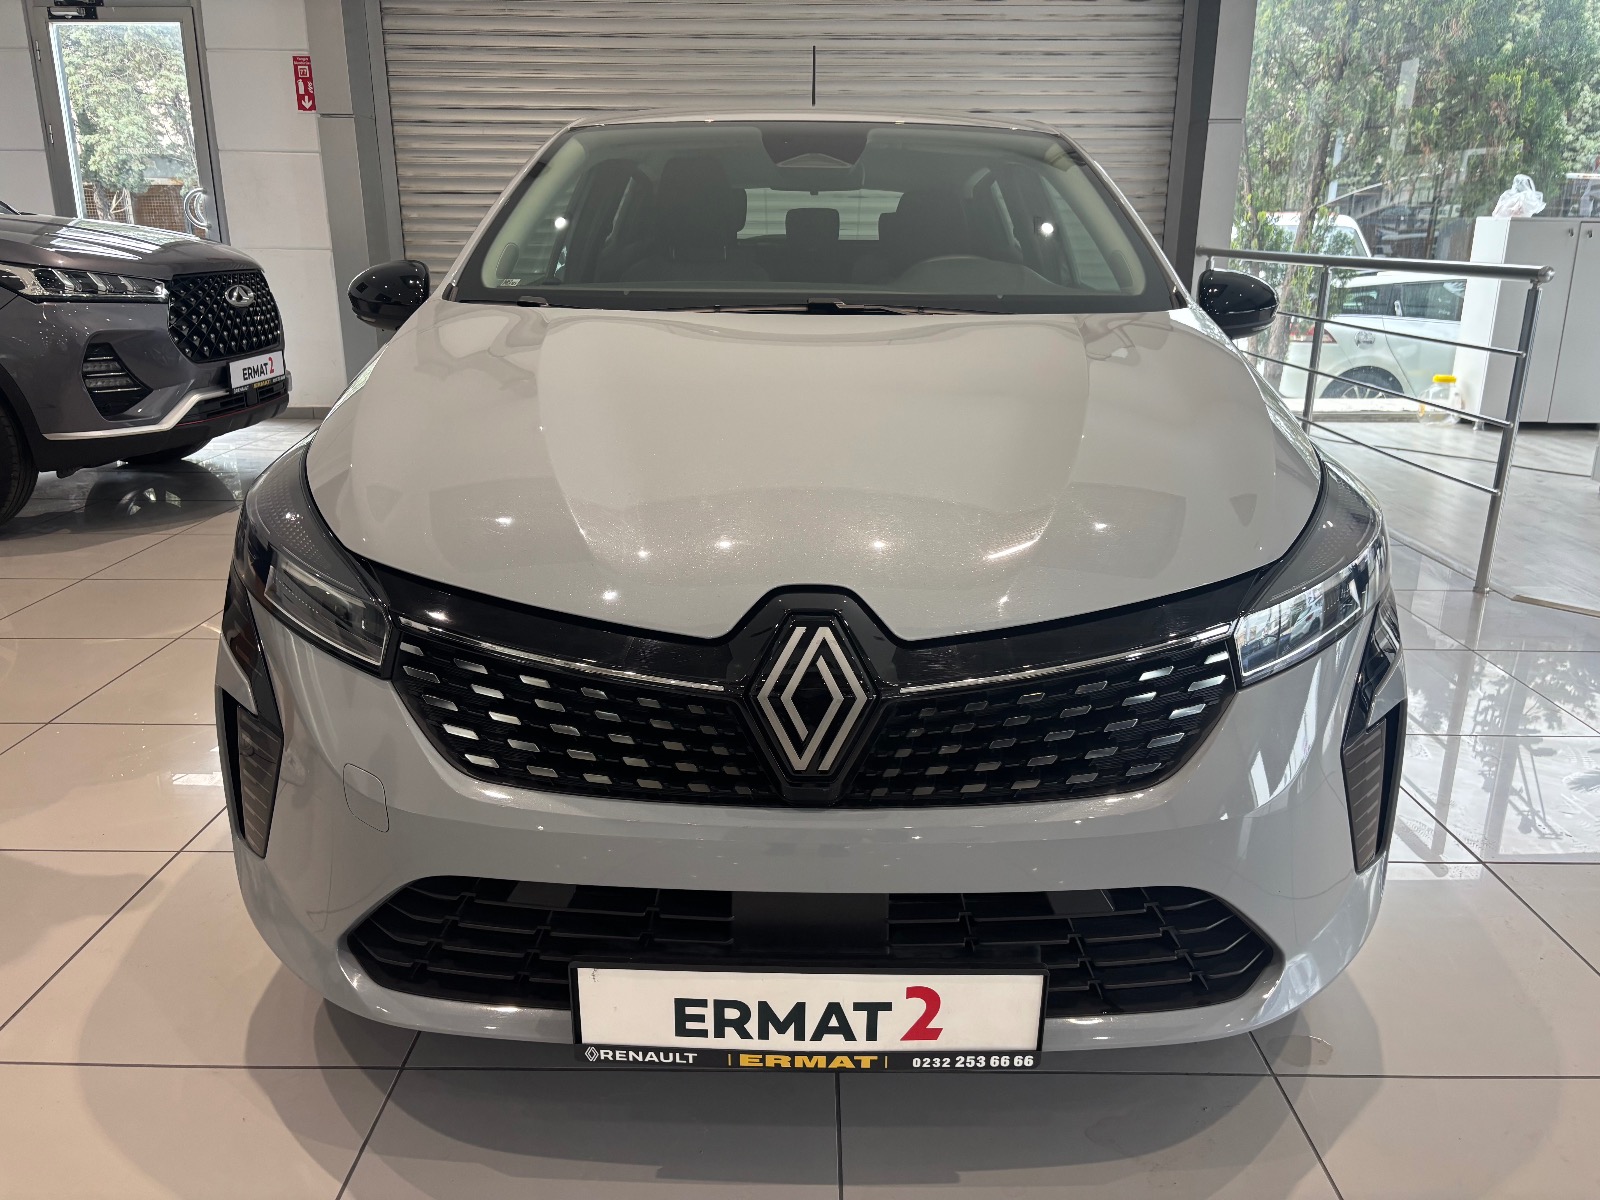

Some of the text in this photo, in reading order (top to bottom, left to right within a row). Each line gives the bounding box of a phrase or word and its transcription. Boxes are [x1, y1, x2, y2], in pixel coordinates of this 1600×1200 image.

[242, 362, 268, 381] ERMAT
[268, 356, 275, 374] 2
[673, 985, 944, 1042] ERMAT 2
[599, 1049, 1034, 1069] RENAULT ERMAT 0232 253 66 66
